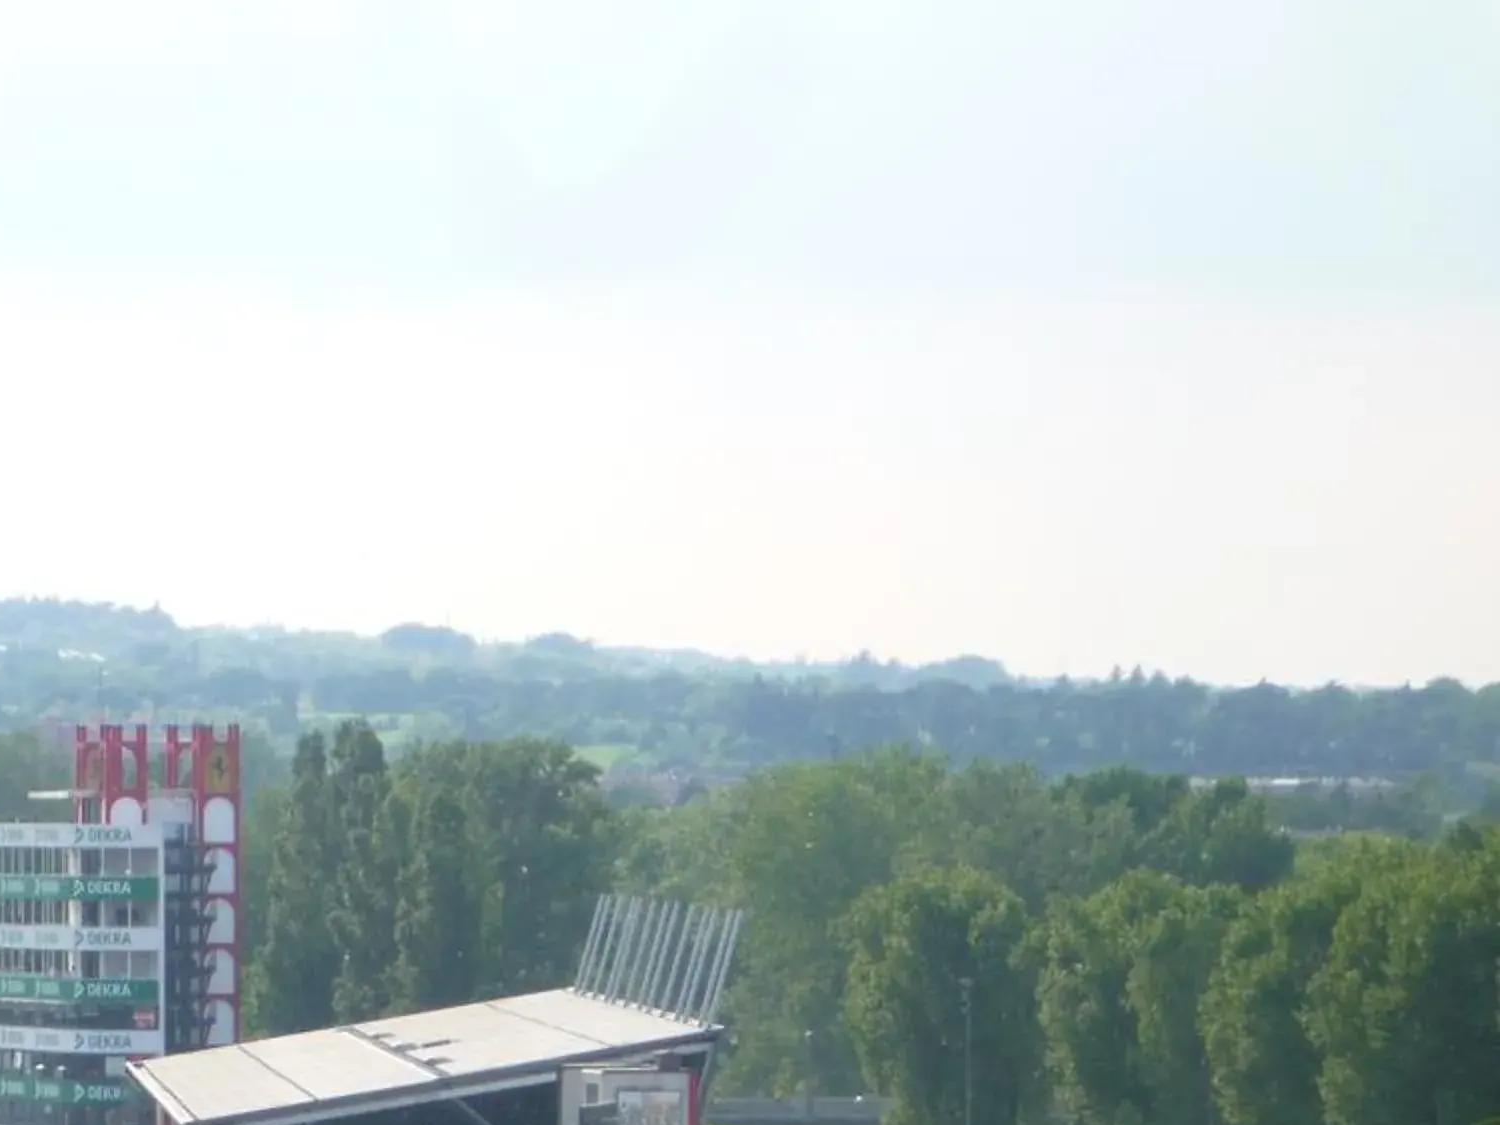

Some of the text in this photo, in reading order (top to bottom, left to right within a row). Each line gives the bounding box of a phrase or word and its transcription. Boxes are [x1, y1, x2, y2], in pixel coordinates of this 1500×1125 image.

[88, 827, 132, 842] DEKRA
[87, 881, 131, 895] DEKRA
[87, 983, 131, 998] DEKRA
[88, 1034, 132, 1048] DEKRA
